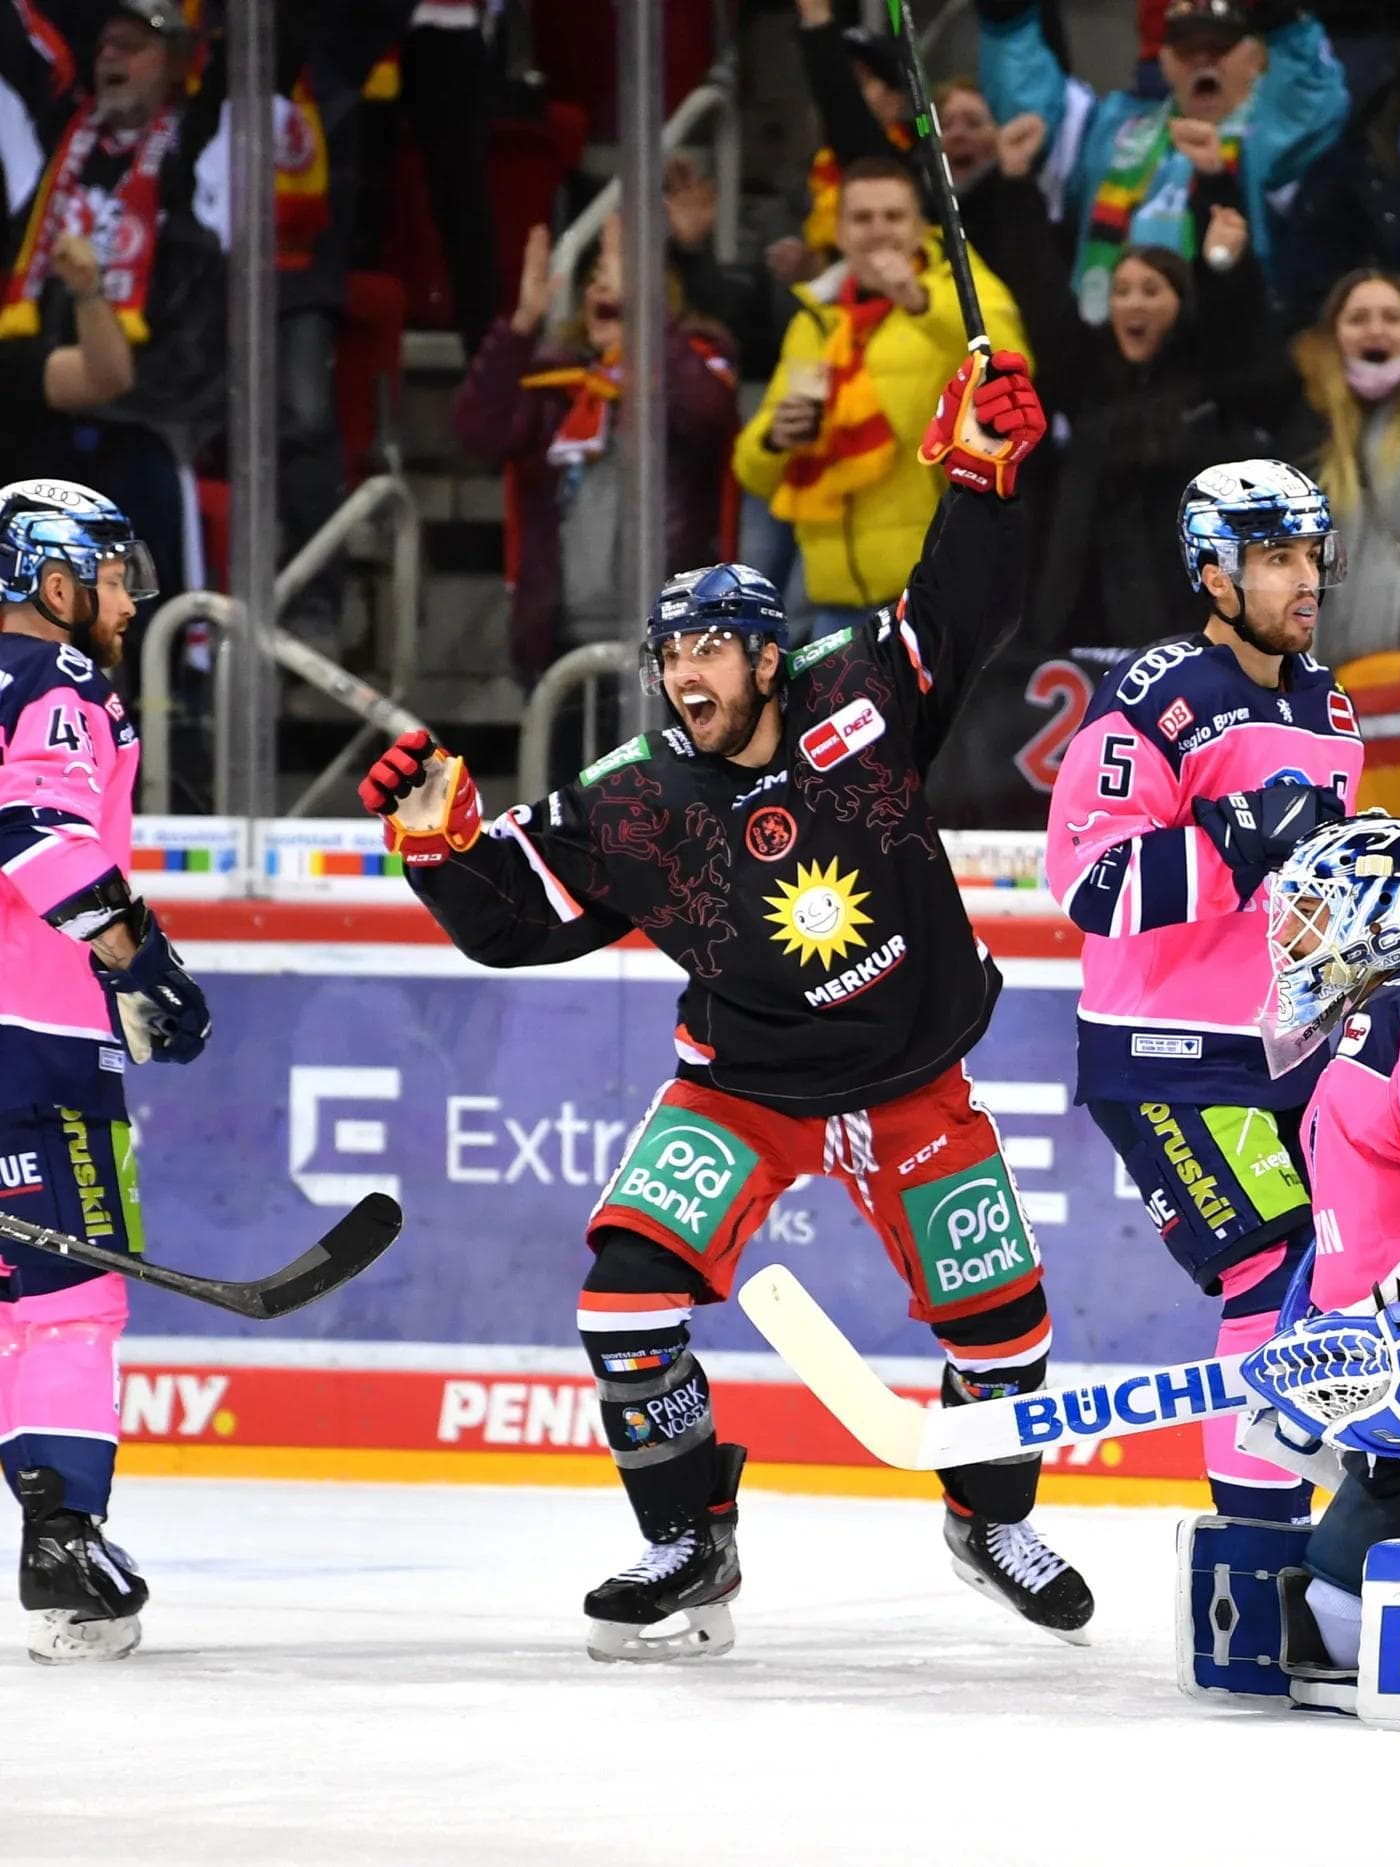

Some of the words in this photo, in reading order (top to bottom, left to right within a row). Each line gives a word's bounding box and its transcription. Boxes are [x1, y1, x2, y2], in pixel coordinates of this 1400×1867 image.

[1160, 705, 1189, 737] DB
[1098, 733, 1136, 799] 5
[804, 935, 906, 1007] MERKUR
[657, 1140, 734, 1200] psd
[898, 1133, 949, 1175] CCM
[620, 1167, 709, 1234] Bank
[947, 1190, 1011, 1251] psd
[935, 1237, 1024, 1292] Bank
[118, 1374, 236, 1437] NY.
[437, 1380, 609, 1446] PENN
[646, 1378, 706, 1425] PARK
[1013, 1362, 1248, 1447] BÜCHL
